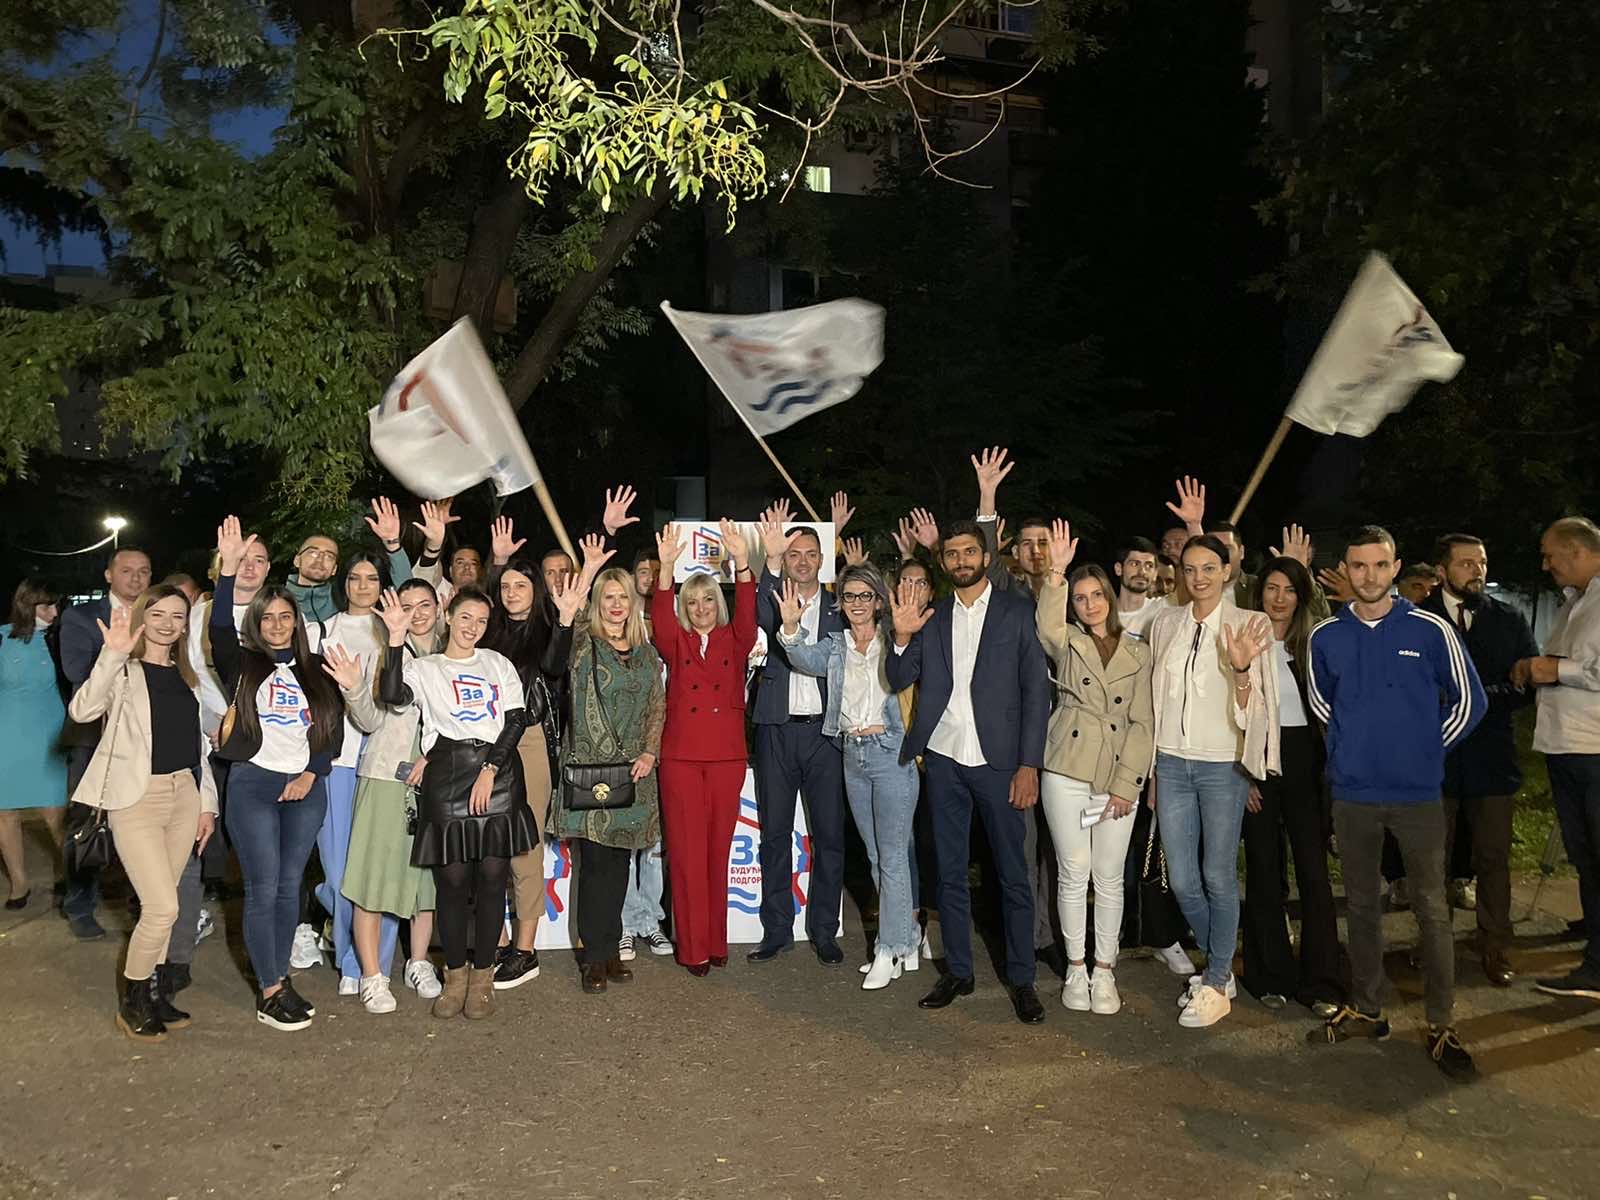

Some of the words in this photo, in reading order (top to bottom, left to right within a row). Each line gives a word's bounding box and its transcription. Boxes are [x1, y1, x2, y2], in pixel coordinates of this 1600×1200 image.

[699, 543, 720, 556] За
[276, 692, 299, 705] За
[461, 688, 484, 700] За
[731, 835, 761, 865] З
